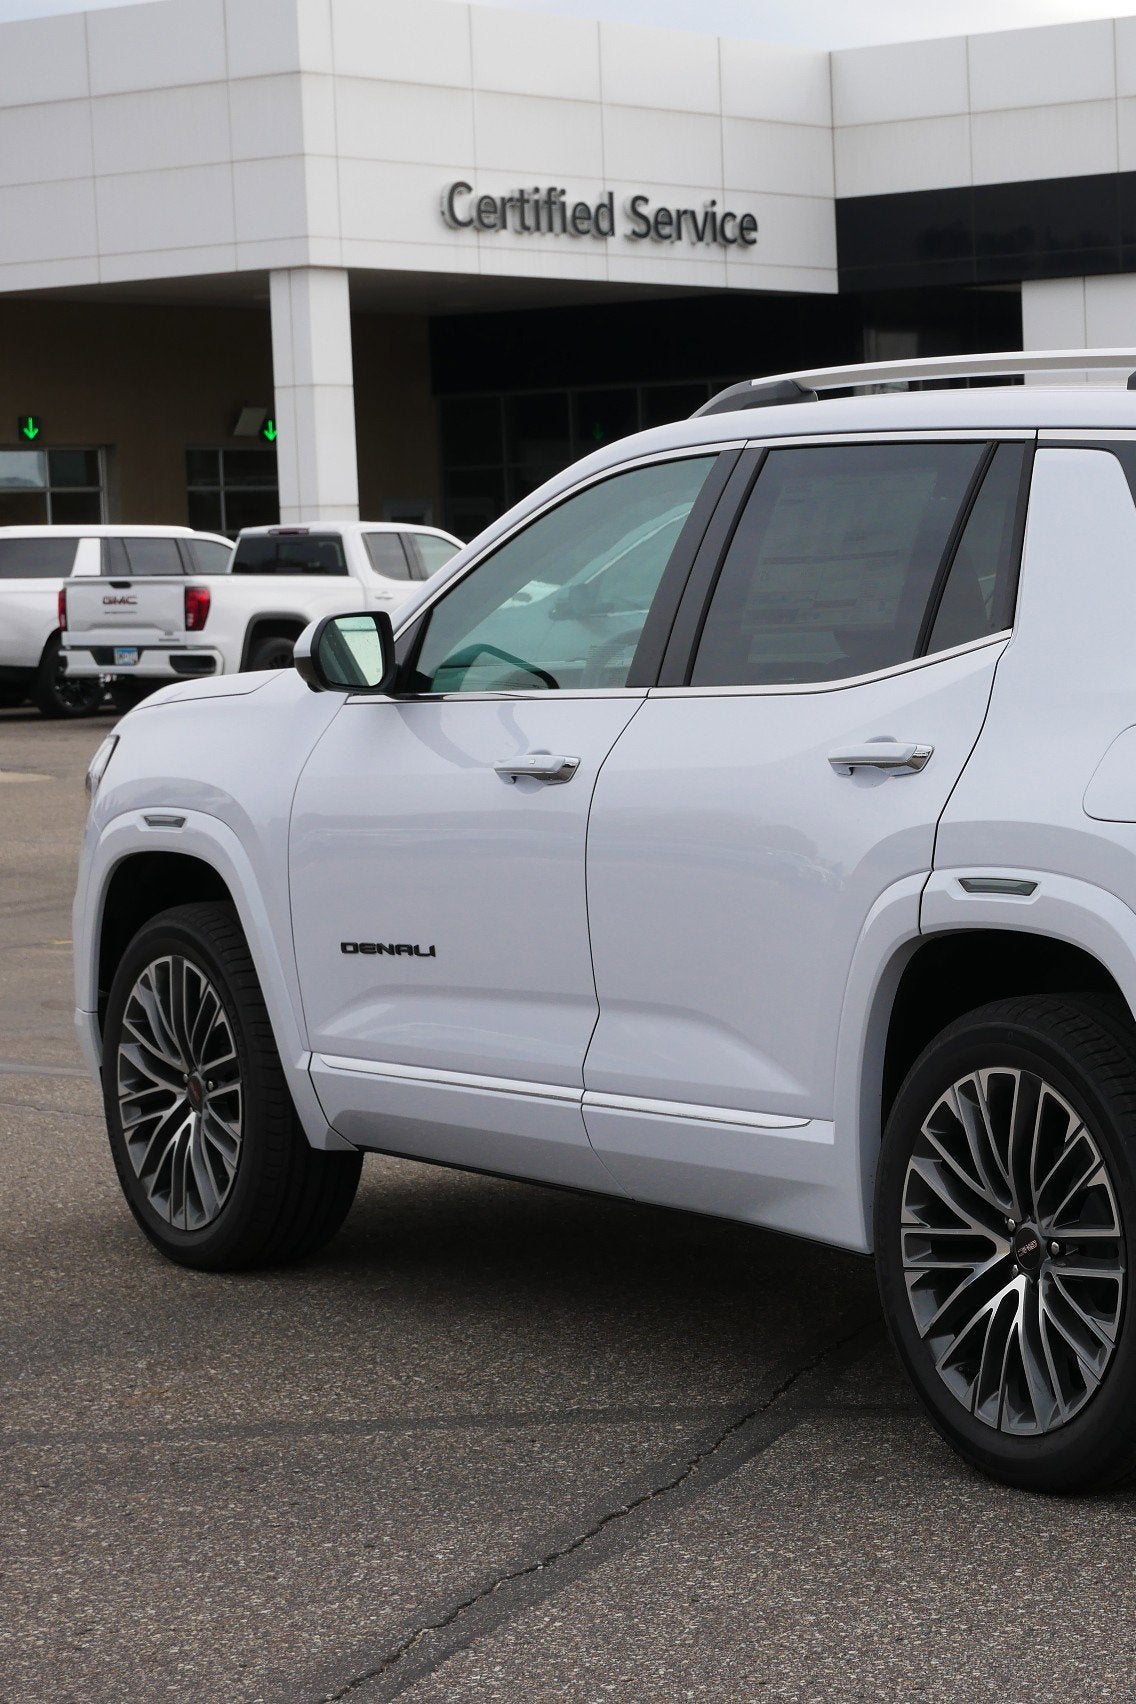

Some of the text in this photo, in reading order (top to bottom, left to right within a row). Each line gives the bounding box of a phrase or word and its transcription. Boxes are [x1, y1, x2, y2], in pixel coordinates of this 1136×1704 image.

[444, 181, 758, 245] Certified Service
[340, 942, 437, 957] DENALI
